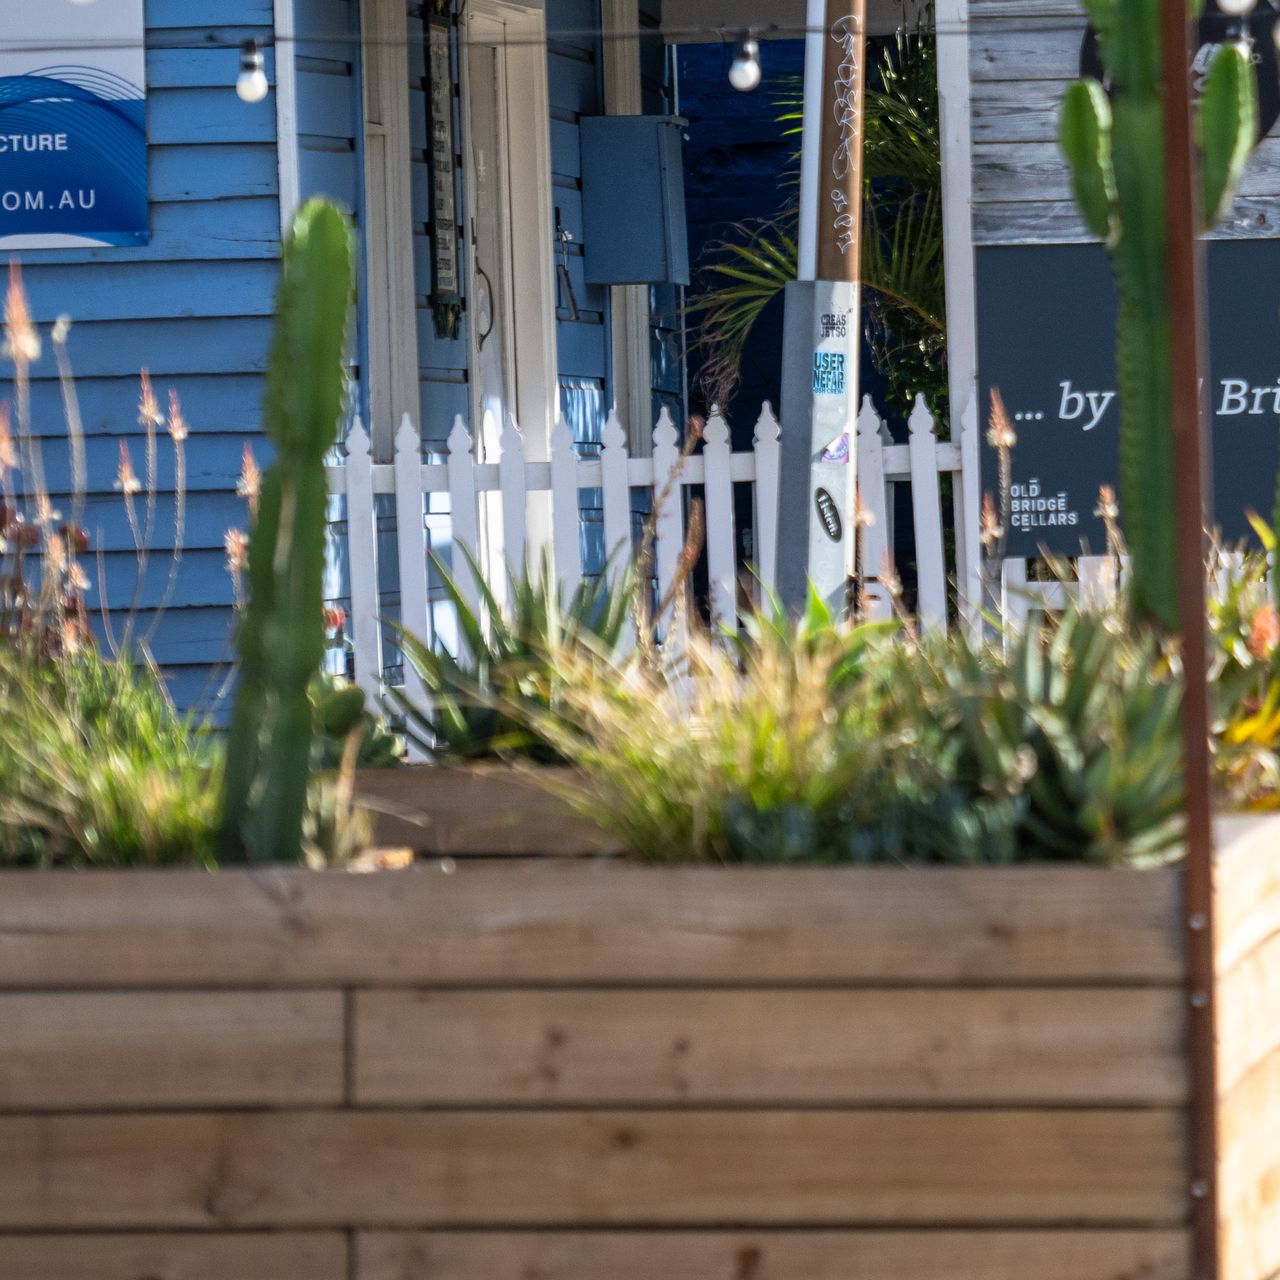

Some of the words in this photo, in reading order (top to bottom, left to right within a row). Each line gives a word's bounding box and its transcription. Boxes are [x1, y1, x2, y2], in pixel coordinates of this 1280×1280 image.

[2, 188, 96, 212] OM.AU
[814, 351, 845, 372] USER
[813, 370, 845, 390] NEFAR
[1058, 380, 1116, 432] by
[1010, 482, 1040, 498] OLD
[1011, 496, 1067, 513] BRIDGE
[1011, 512, 1079, 528] CELLARS
